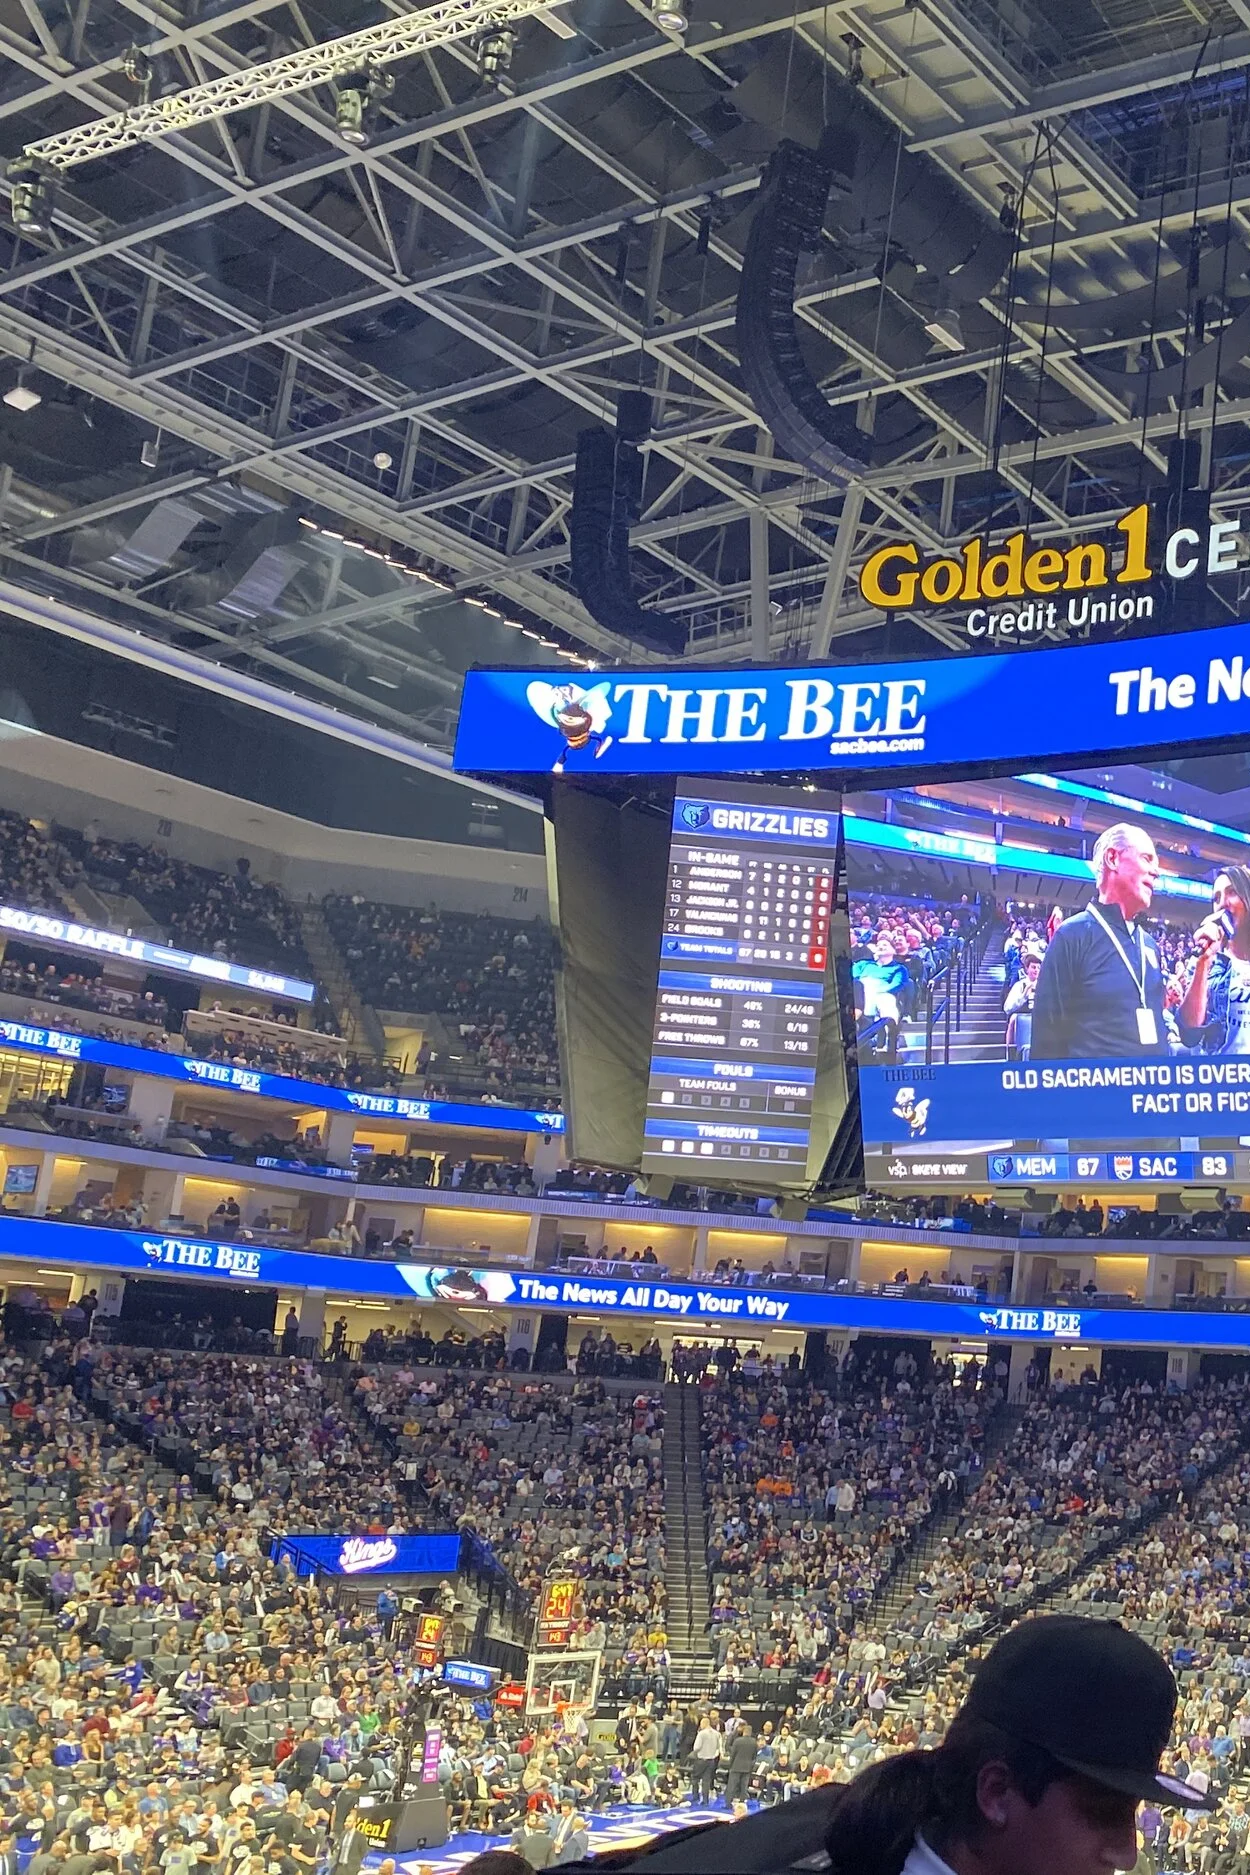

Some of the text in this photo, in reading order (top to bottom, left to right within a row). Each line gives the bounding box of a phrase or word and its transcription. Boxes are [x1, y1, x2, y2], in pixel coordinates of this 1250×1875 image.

[967, 592, 1153, 637] Credit Union
[1109, 666, 1197, 716] The
[614, 678, 927, 744] THE BEE
[829, 737, 926, 756] sacbee.com
[712, 808, 830, 839] GRIZZLIES
[688, 850, 740, 866] IN-GAME
[689, 866, 742, 880] ANDERSON
[749, 872, 756, 881] 7
[764, 873, 771, 883] 3
[808, 876, 814, 886] 1
[672, 880, 769, 896] 12 MORANT 4 1
[670, 895, 681, 903] 13
[669, 909, 679, 917] 17
[776, 917, 781, 926] 1
[818, 921, 824, 930] 1
[66, 924, 145, 960] RAFFLE
[667, 923, 680, 932] 24
[774, 933, 779, 941] 1
[789, 934, 794, 943] 1
[817, 936, 822, 945] 1
[710, 977, 773, 993] SHOOTING
[662, 994, 722, 1008] FIELD GOALS
[660, 1012, 718, 1026] 3-POINTERS
[8, 1026, 81, 1052] THE BEE
[658, 1031, 683, 1042] FREE
[684, 1032, 726, 1045] THROWS
[198, 1063, 261, 1088] THE BEE
[713, 1063, 754, 1077] FOULS
[882, 1067, 936, 1083] THE BEE
[1002, 1070, 1038, 1090] OLD
[1041, 1065, 1171, 1088] SACRAMENTO
[1175, 1064, 1194, 1085] IS
[679, 1078, 807, 1096] TEAM FOULS BONUS
[360, 1098, 430, 1116] THE BEE
[1131, 1093, 1181, 1113] FACT
[1185, 1091, 1212, 1113] OR
[697, 1125, 759, 1140] TIMEOUTS
[941, 1164, 967, 1175] VIEW
[1016, 1157, 1056, 1176] MEM
[1139, 1157, 1178, 1176] SAC
[161, 1240, 261, 1272] THE BEE
[518, 1278, 789, 1321] The News All Day Your Way
[997, 1309, 1081, 1333] THE BEE
[339, 1537, 398, 1573] Kings
[546, 1598, 567, 1618] 24
